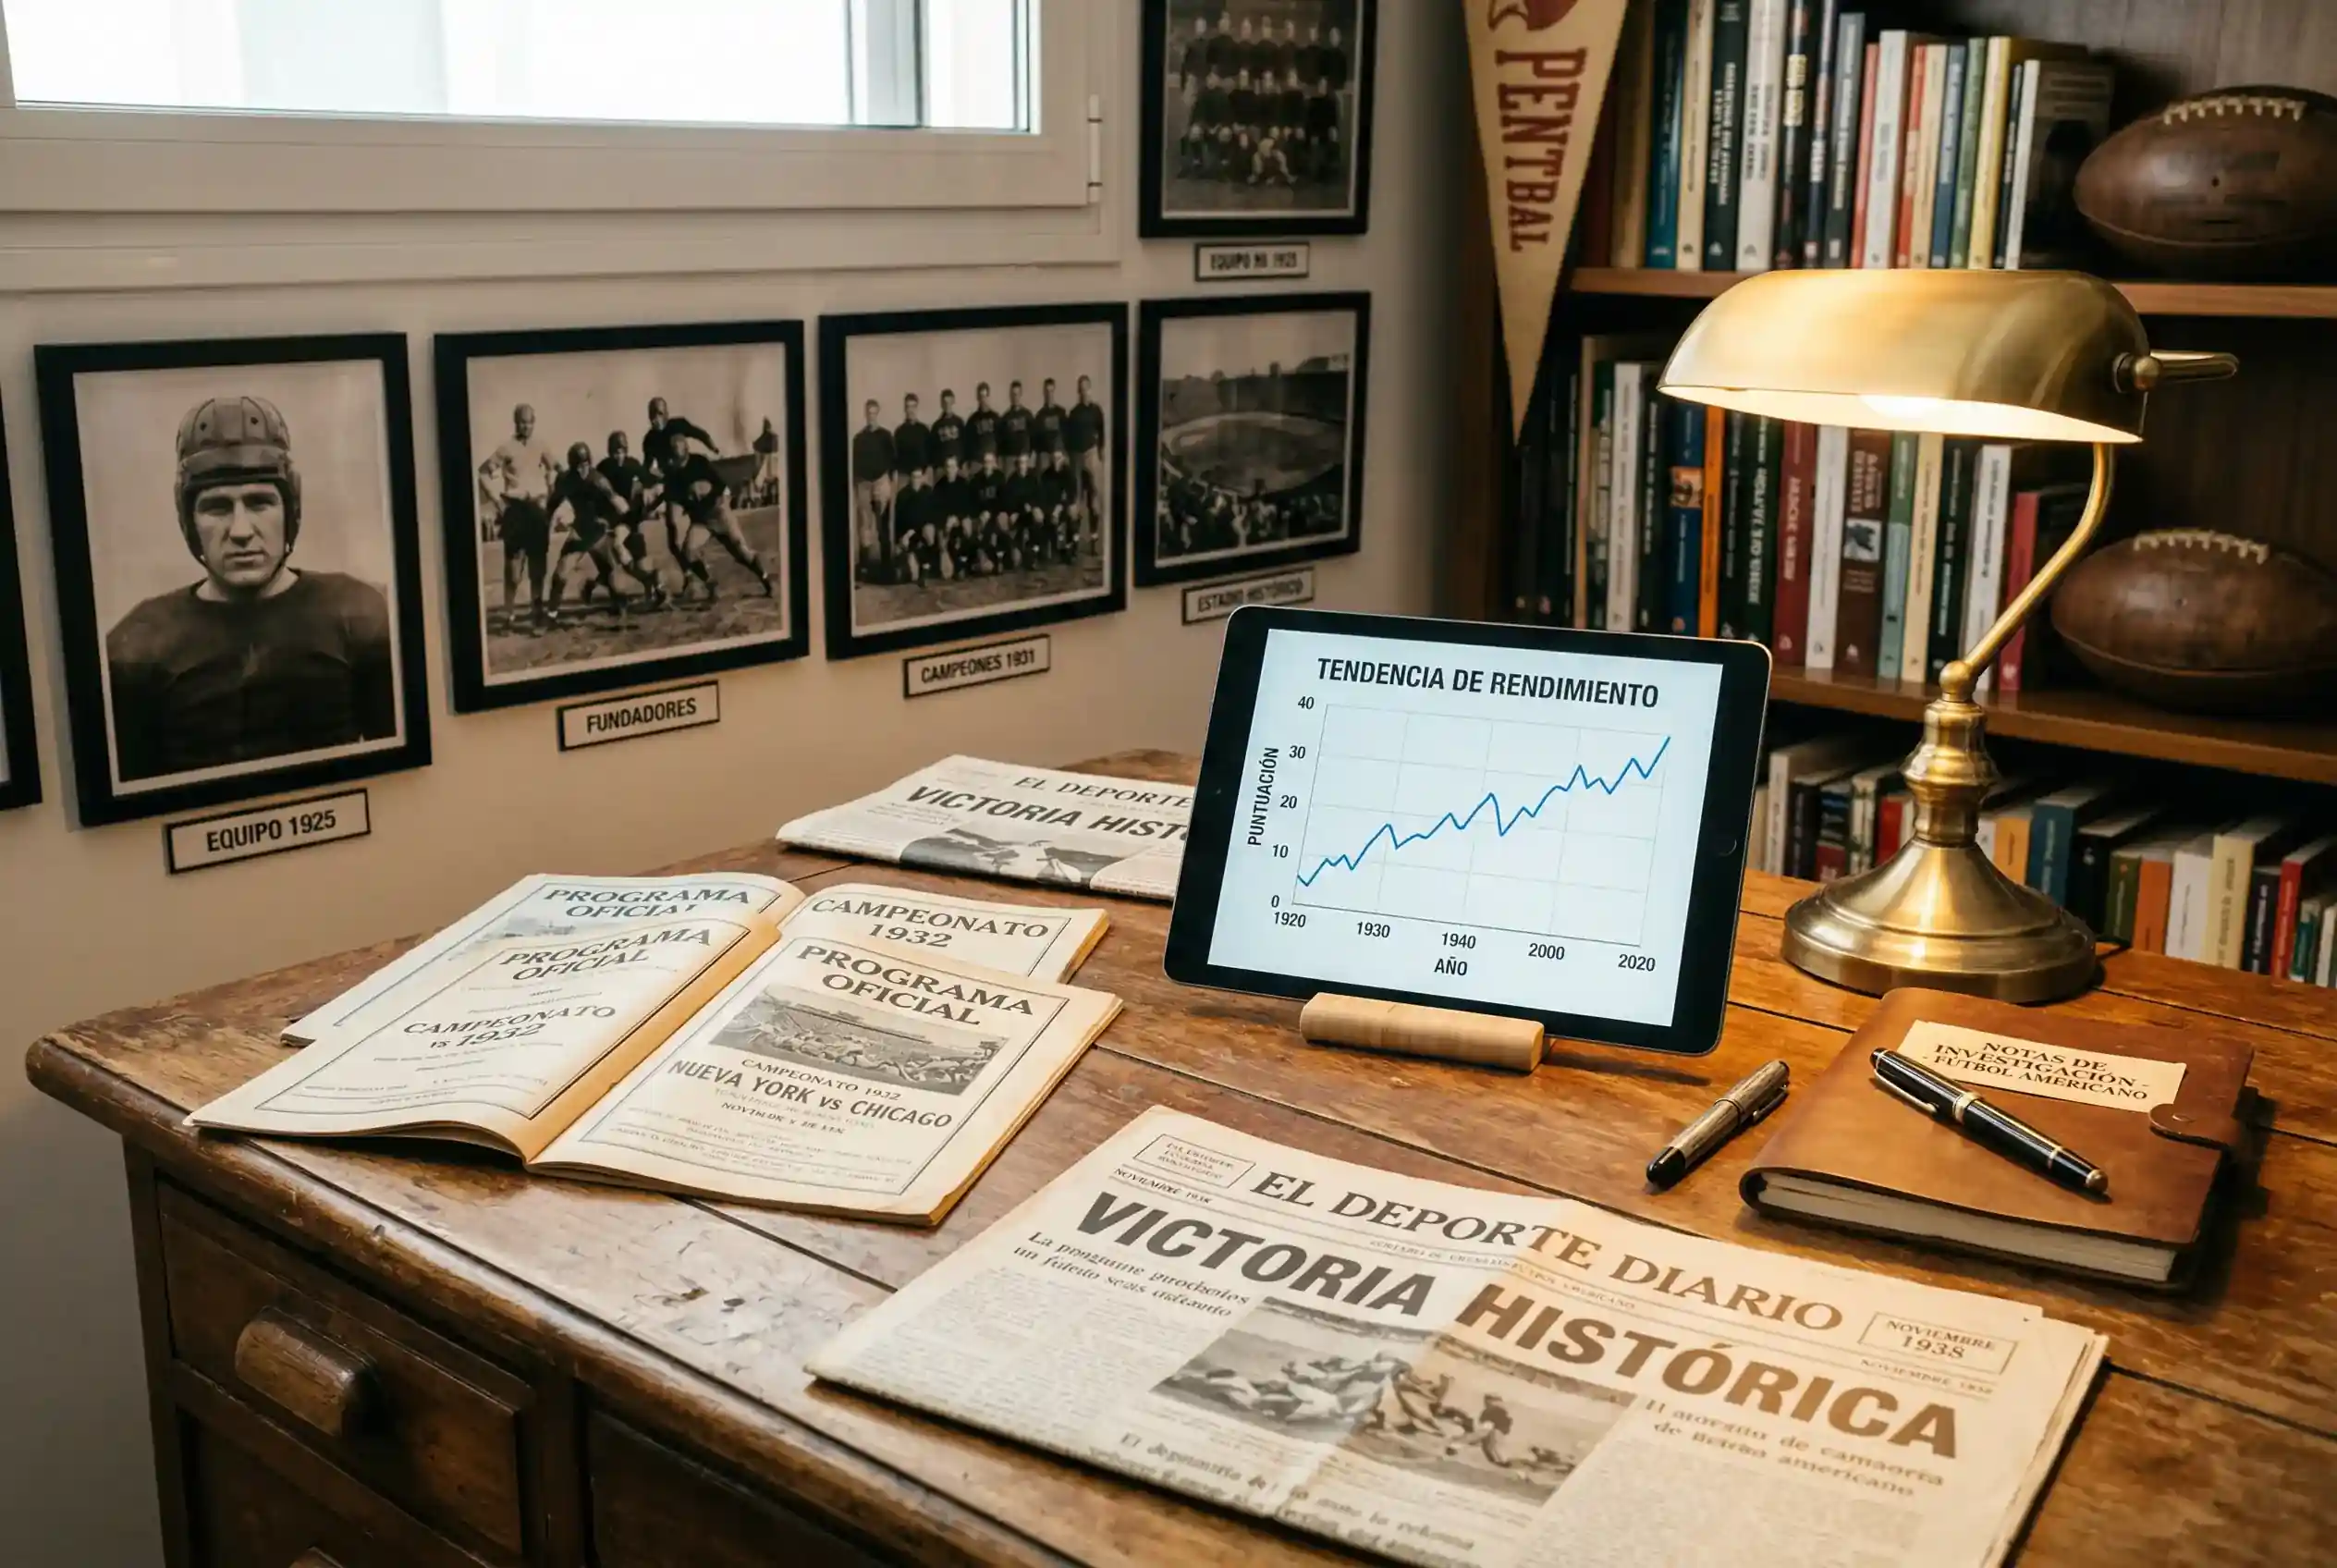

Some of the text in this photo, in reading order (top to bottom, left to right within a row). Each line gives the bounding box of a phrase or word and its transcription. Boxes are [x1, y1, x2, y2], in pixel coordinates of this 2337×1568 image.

[1495, 48, 1587, 252] PENTBAL
[921, 648, 1035, 684] CAMPEONES 1931
[1317, 657, 1659, 708] TENDENCIA DE RENDIMIENTO
[586, 697, 697, 734] FUNDADORES
[1297, 696, 1315, 710] 40
[1289, 745, 1306, 759] 30
[1013, 777, 1193, 809] EL DEPORTE
[1247, 747, 1279, 846] PUNTUACIÓN
[1279, 795, 1298, 809] 20
[206, 809, 336, 852] EQUIPO 1925
[906, 785, 1083, 827] VICTORIA
[1087, 815, 1188, 841] HIST
[1272, 844, 1289, 858] 10
[544, 888, 750, 904] PROGRAMA
[1270, 894, 1280, 909] 0
[811, 898, 1050, 938] CAMPEONATO
[499, 927, 711, 967] PROGRAMA
[869, 923, 954, 949] 1932
[1274, 912, 1657, 973] 1920 1930 1940 2000 2020
[512, 948, 650, 981] OFICIAL
[796, 944, 1034, 1016] PROGRAMA
[1433, 956, 1469, 977] AÑO
[822, 974, 981, 1026] OFICIAL
[403, 1004, 617, 1035] CAMPEONATO
[455, 1022, 547, 1047] 1932
[1933, 1043, 2138, 1088] INVESTIGACIÓN
[1982, 1042, 2109, 1072] NOTAS DE
[740, 1058, 859, 1093] CAMPEONATO
[2017, 1072, 2148, 1101] AMERICANO
[667, 1059, 744, 1089] NUEVA
[752, 1076, 816, 1105] YORK
[850, 1099, 953, 1129] CHICAGO
[1249, 1170, 1844, 1331] EL DEPORTE DIARIO
[1075, 1190, 1958, 1461] VICTORIA HISTÓRICA
[1886, 1319, 1996, 1351] NOVIEMBRE
[1902, 1335, 1966, 1359] 1938
[1777, 1453, 1915, 1497] americano
